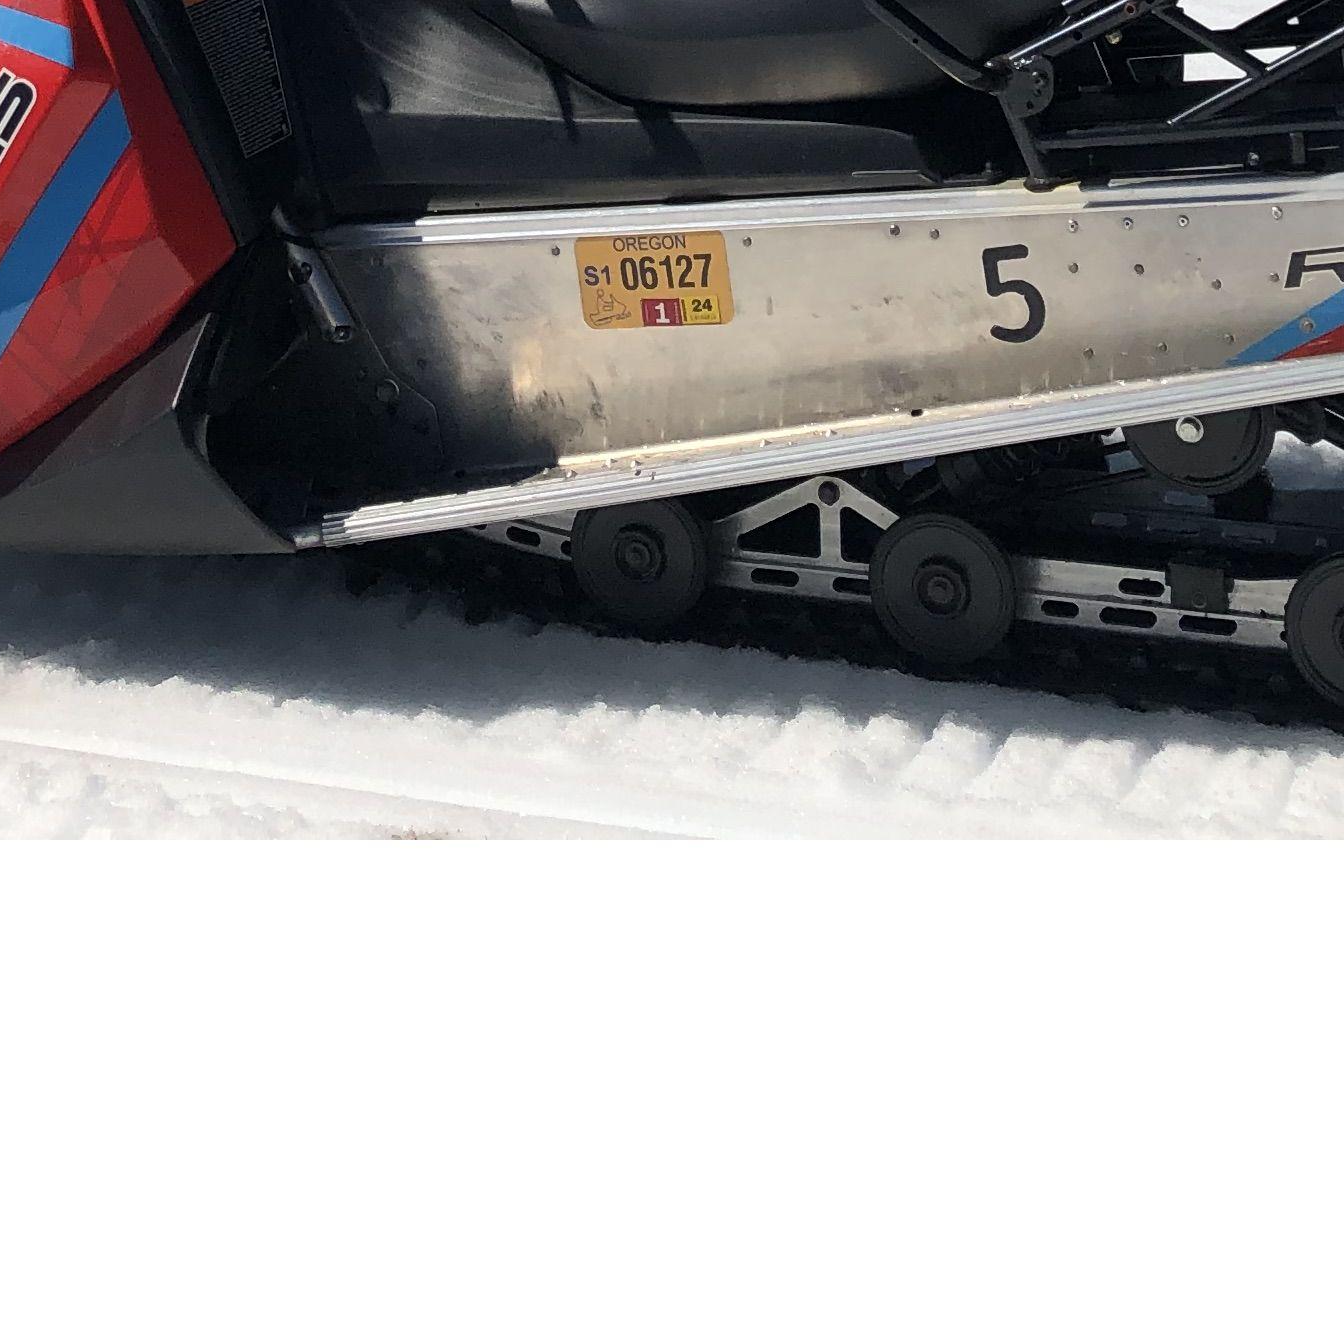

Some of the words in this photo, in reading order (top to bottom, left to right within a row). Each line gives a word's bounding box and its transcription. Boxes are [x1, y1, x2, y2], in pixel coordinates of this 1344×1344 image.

[613, 235, 686, 252] OREGON
[584, 265, 611, 286] S1
[620, 253, 712, 291] 06127
[982, 244, 1046, 343] 5
[654, 302, 671, 324] 1
[691, 298, 713, 313] 24
